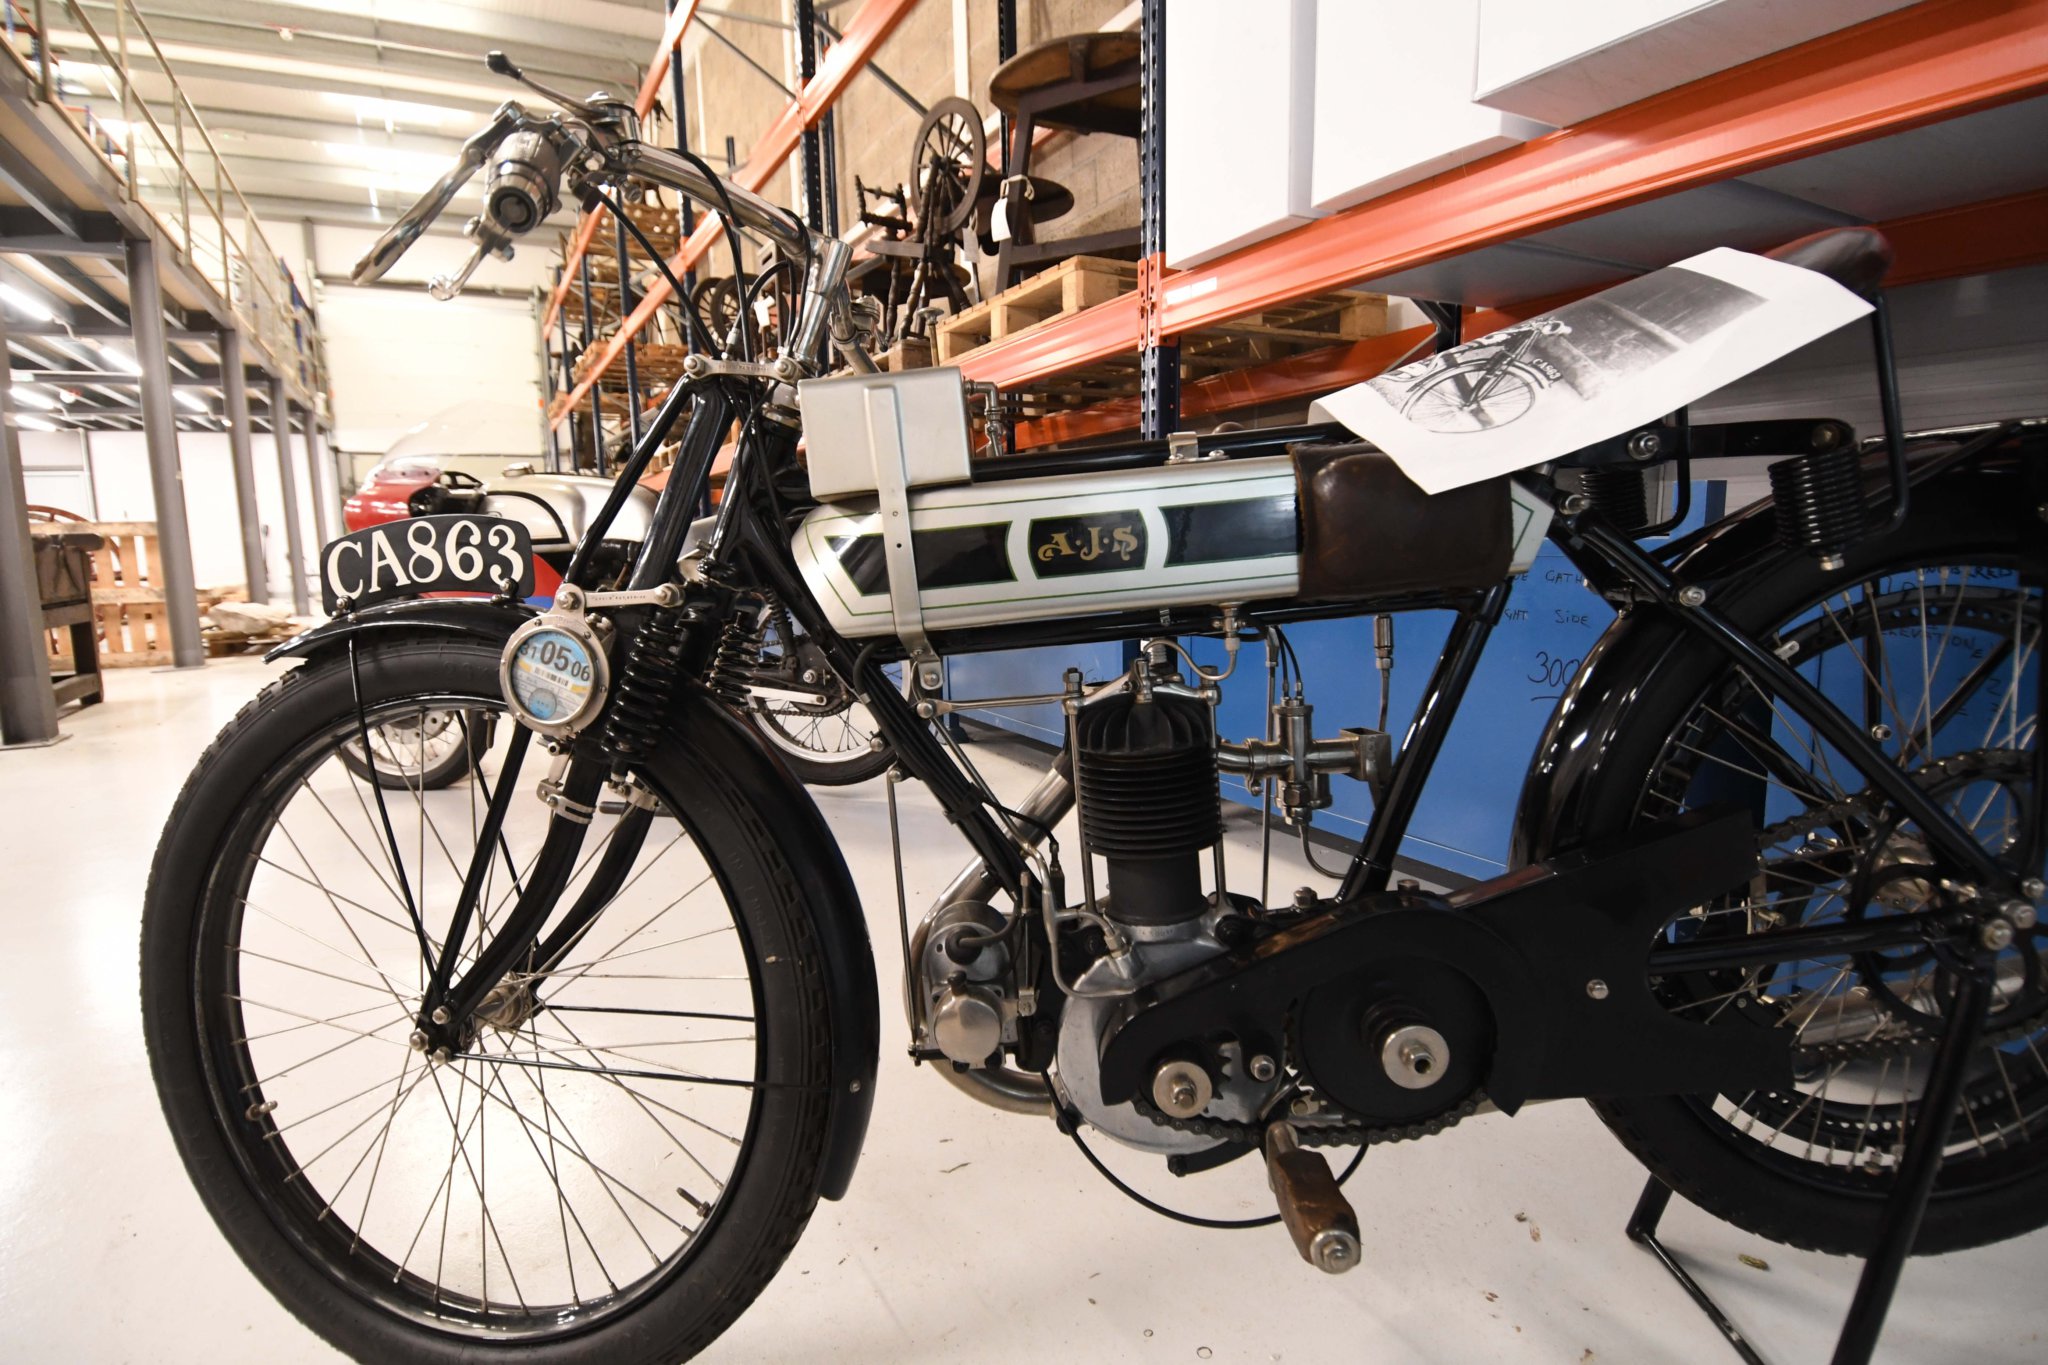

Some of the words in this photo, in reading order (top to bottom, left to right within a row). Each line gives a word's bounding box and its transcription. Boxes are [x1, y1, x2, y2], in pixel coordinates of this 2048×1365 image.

[327, 519, 524, 600] CA863
[540, 640, 572, 672] 05
[571, 660, 591, 682] 06
